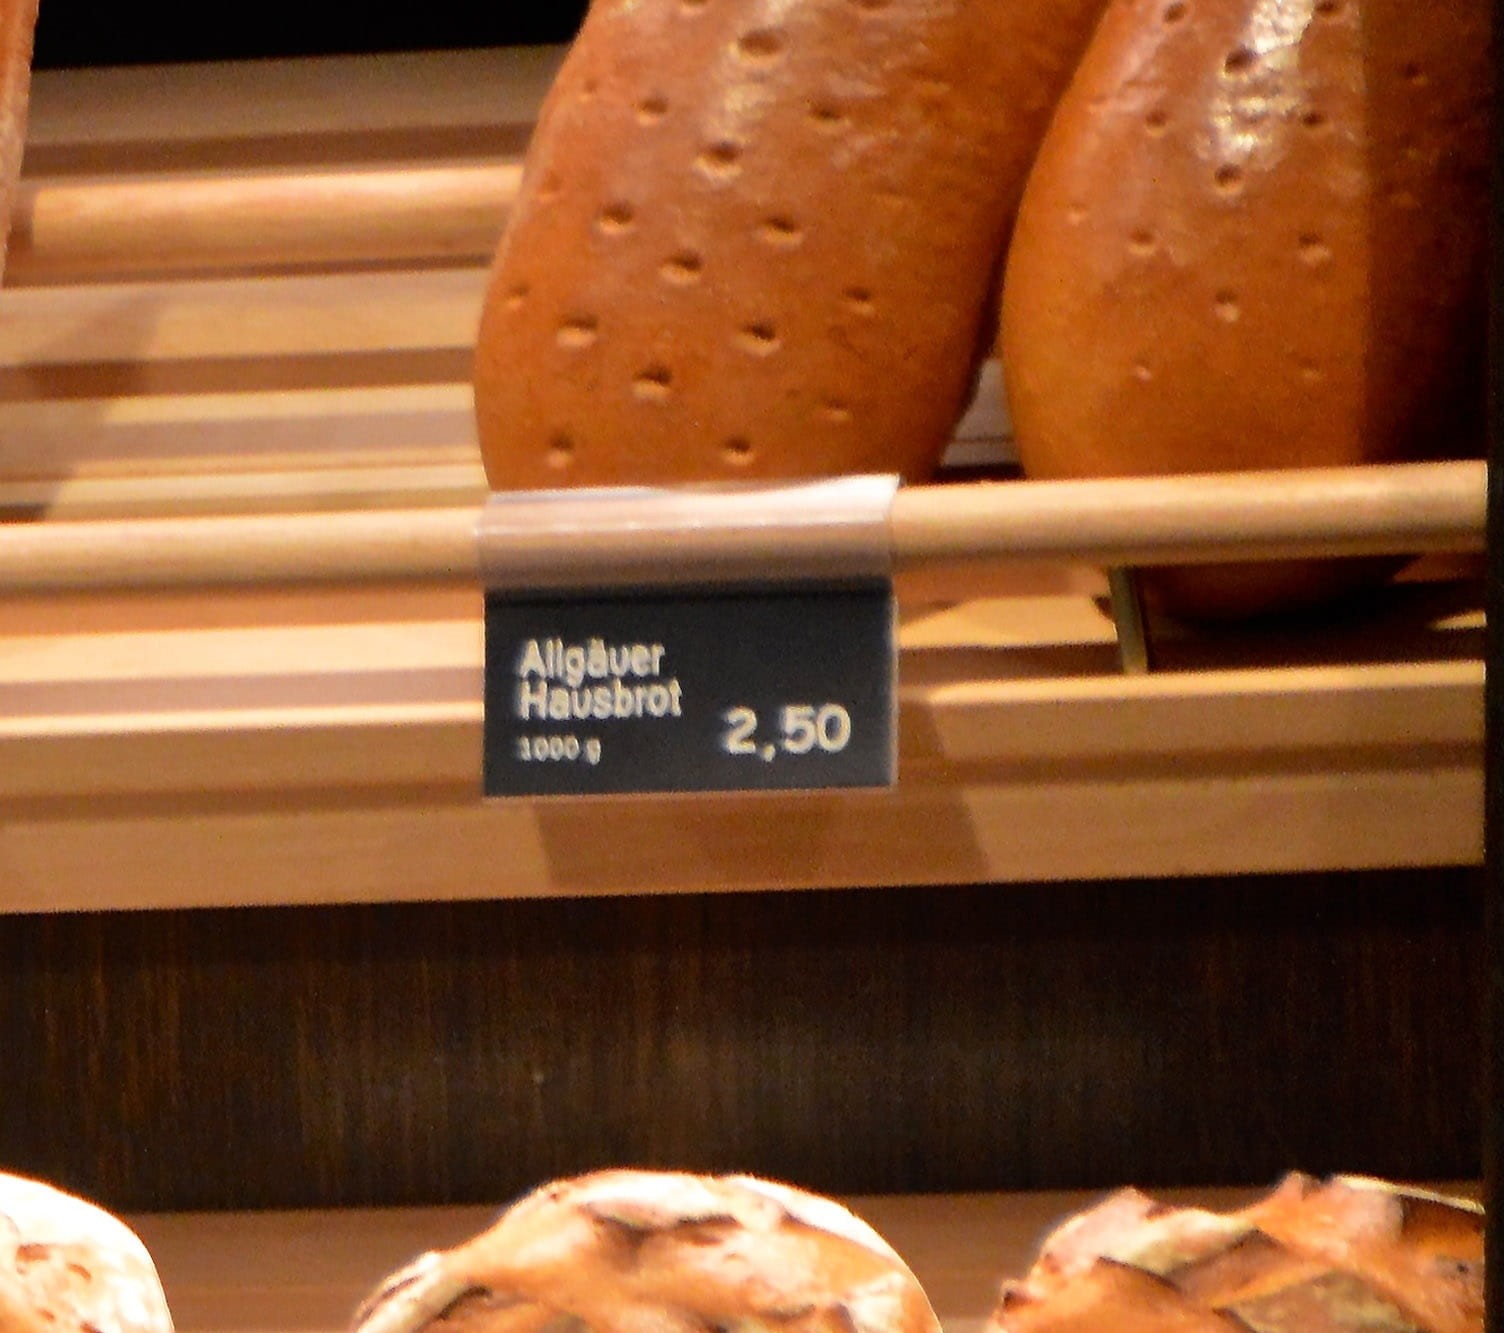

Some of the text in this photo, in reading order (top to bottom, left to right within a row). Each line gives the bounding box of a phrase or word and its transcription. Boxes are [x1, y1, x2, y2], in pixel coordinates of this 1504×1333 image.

[518, 637, 665, 688] Allgäuer
[518, 677, 683, 721] Hausbrot
[517, 703, 852, 766] 1000 g 2,50
